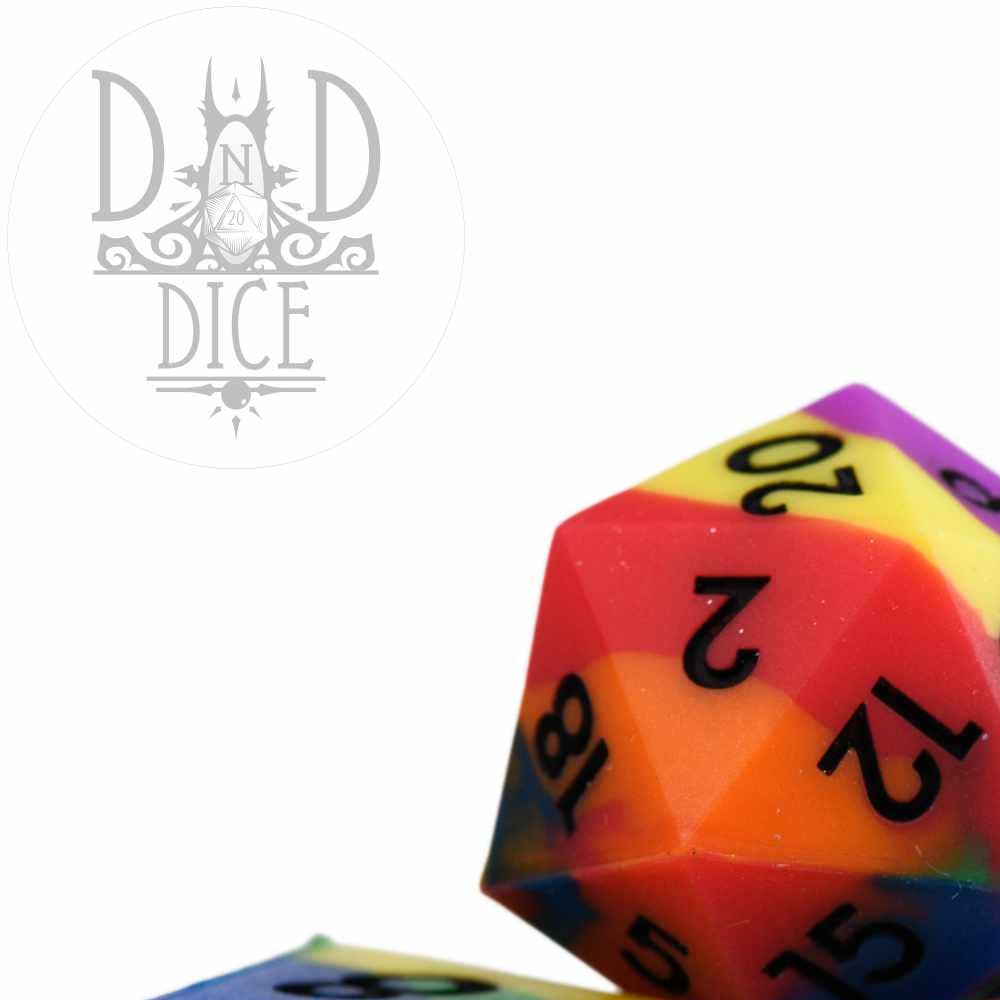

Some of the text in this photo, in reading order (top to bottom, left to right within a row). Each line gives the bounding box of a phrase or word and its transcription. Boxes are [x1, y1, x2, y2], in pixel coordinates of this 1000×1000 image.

[725, 431, 865, 517] 20
[682, 575, 771, 690] 2
[533, 673, 610, 837] 18
[817, 676, 986, 825] 12
[619, 914, 692, 997] 5
